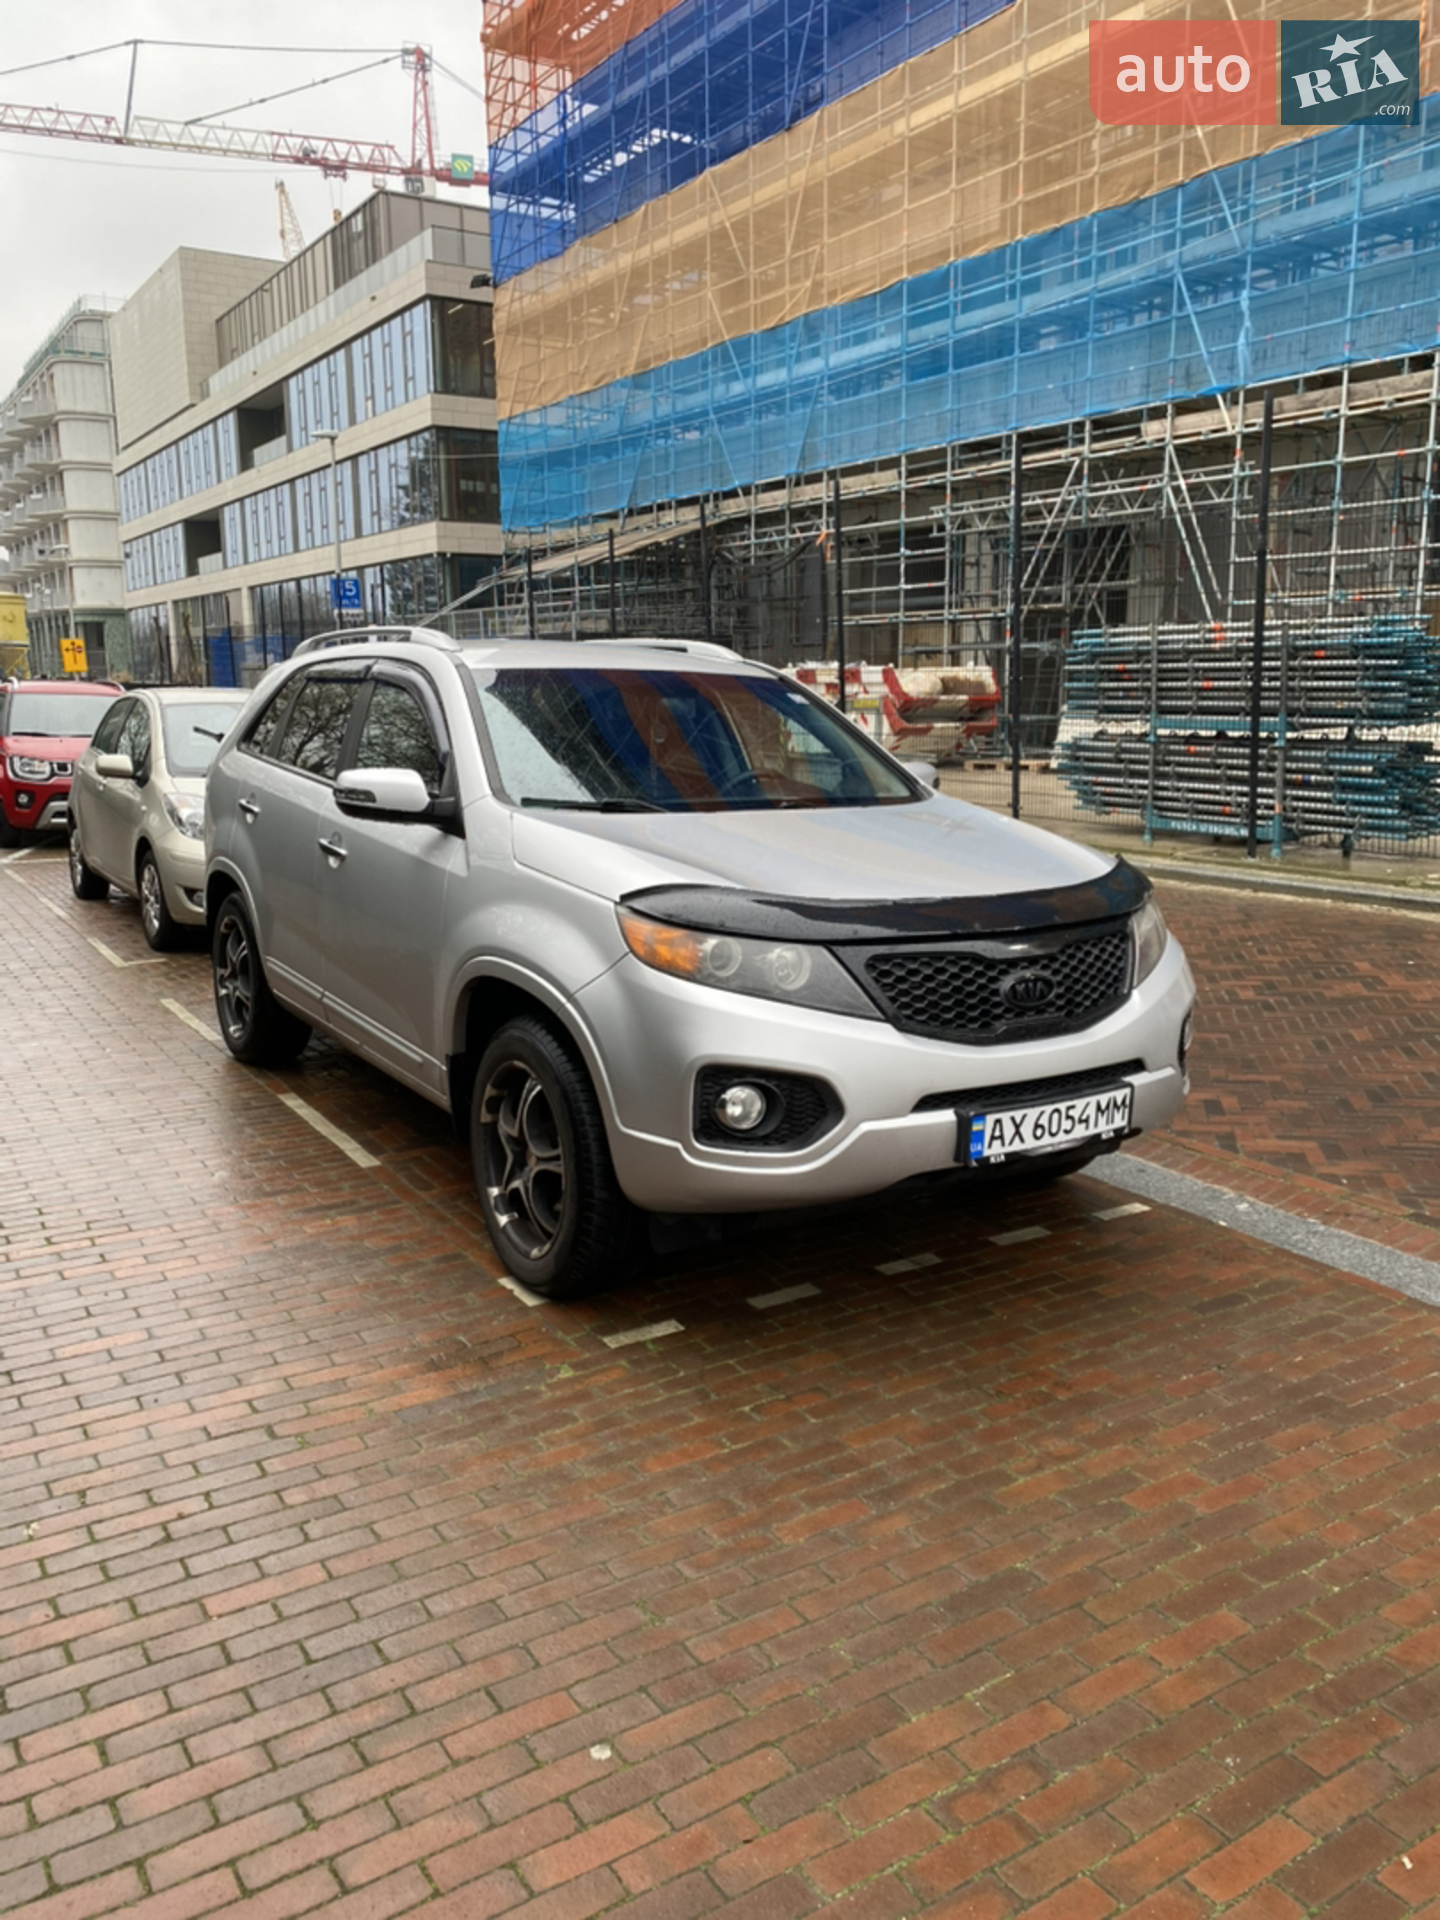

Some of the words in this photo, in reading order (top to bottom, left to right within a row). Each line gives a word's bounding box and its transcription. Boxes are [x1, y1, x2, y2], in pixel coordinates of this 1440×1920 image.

[1014, 980, 1049, 1001] KIA
[987, 1113, 1028, 1150] AX
[1032, 1101, 1091, 1141] 6054
[1094, 1093, 1129, 1129] MM
[970, 1142, 983, 1153] UA
[989, 1153, 1006, 1164] KIA
